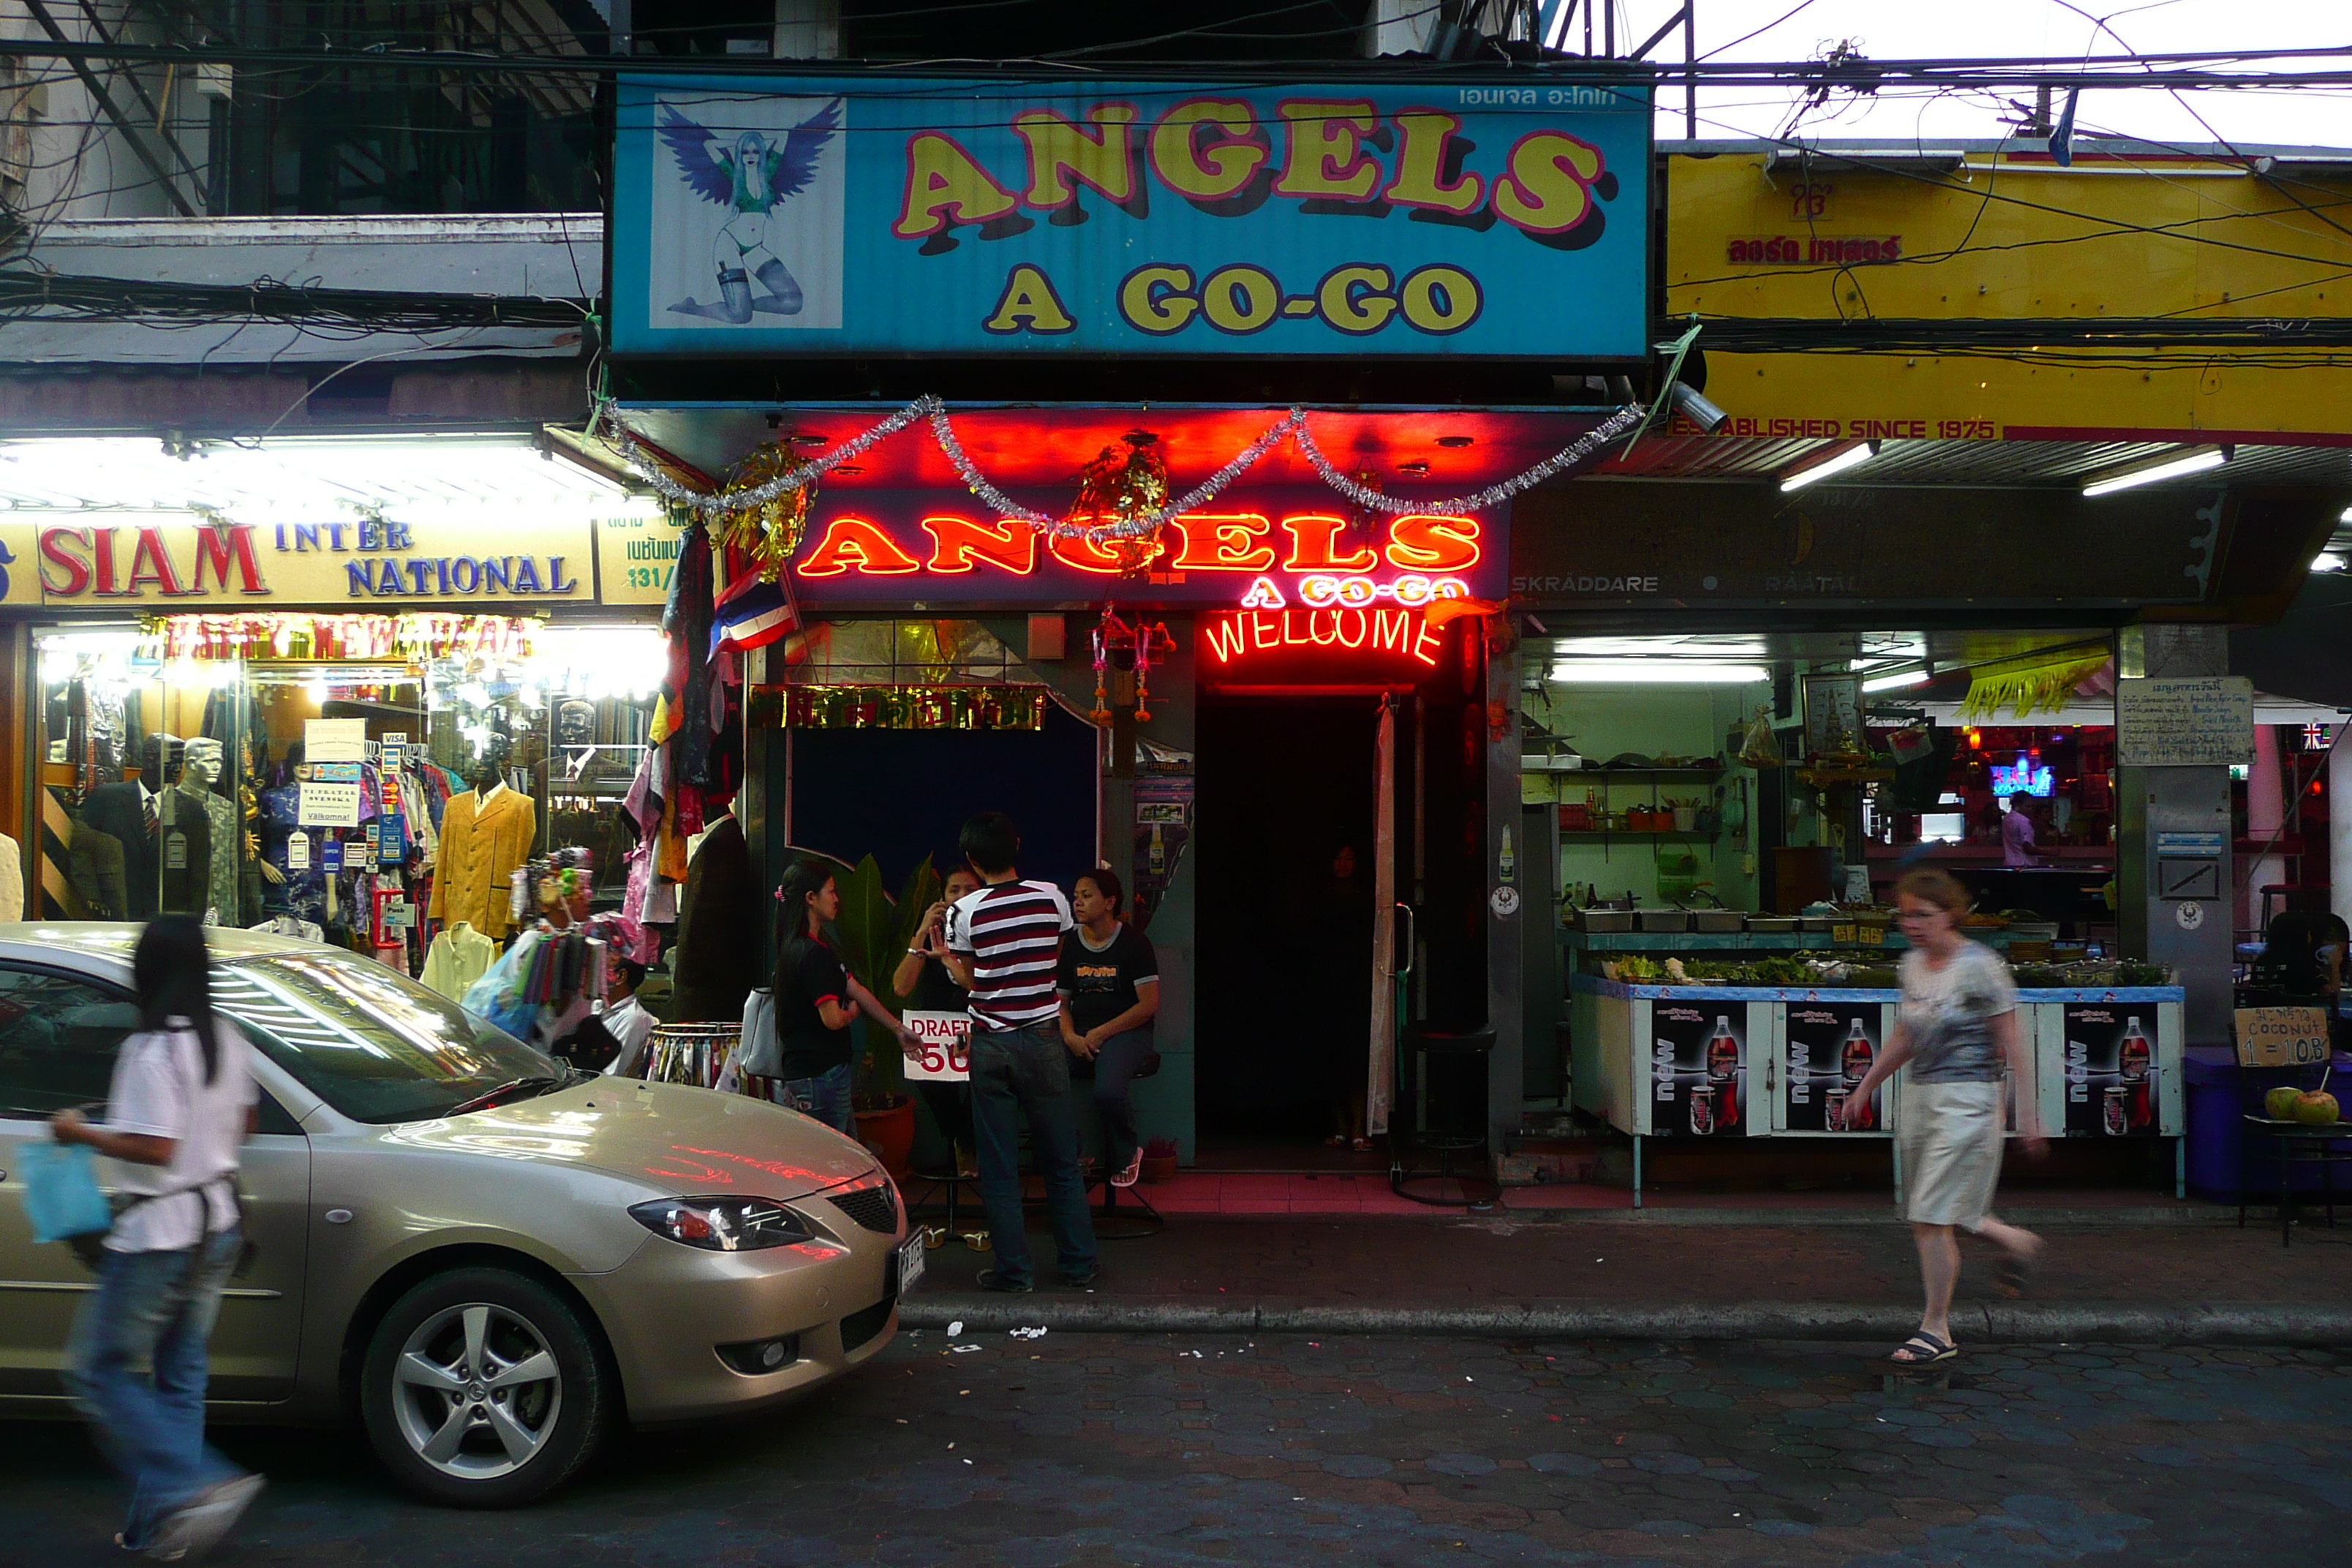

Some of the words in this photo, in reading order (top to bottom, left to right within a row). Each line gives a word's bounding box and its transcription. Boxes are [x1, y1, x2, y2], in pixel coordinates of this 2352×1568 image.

[891, 95, 1606, 240] ANGELS
[981, 262, 1077, 336] A
[1116, 262, 1484, 336] GO-GO
[1671, 417, 1841, 437] ESABLISHED
[1850, 420, 1925, 439] SINCE
[1937, 421, 1995, 439] 1975
[39, 524, 271, 597] SIAM
[275, 522, 415, 552] INTER
[344, 555, 577, 596] NATIONAL
[797, 513, 1482, 578] ANGELS
[1243, 576, 1286, 607] A
[1511, 573, 1659, 592] SKRÄDDARE
[1206, 608, 1446, 666] WELCOME
[911, 1019, 970, 1036] DRAFT
[1656, 1038, 1676, 1101] new
[1791, 1041, 1809, 1104] new
[2070, 1040, 2088, 1103] new
